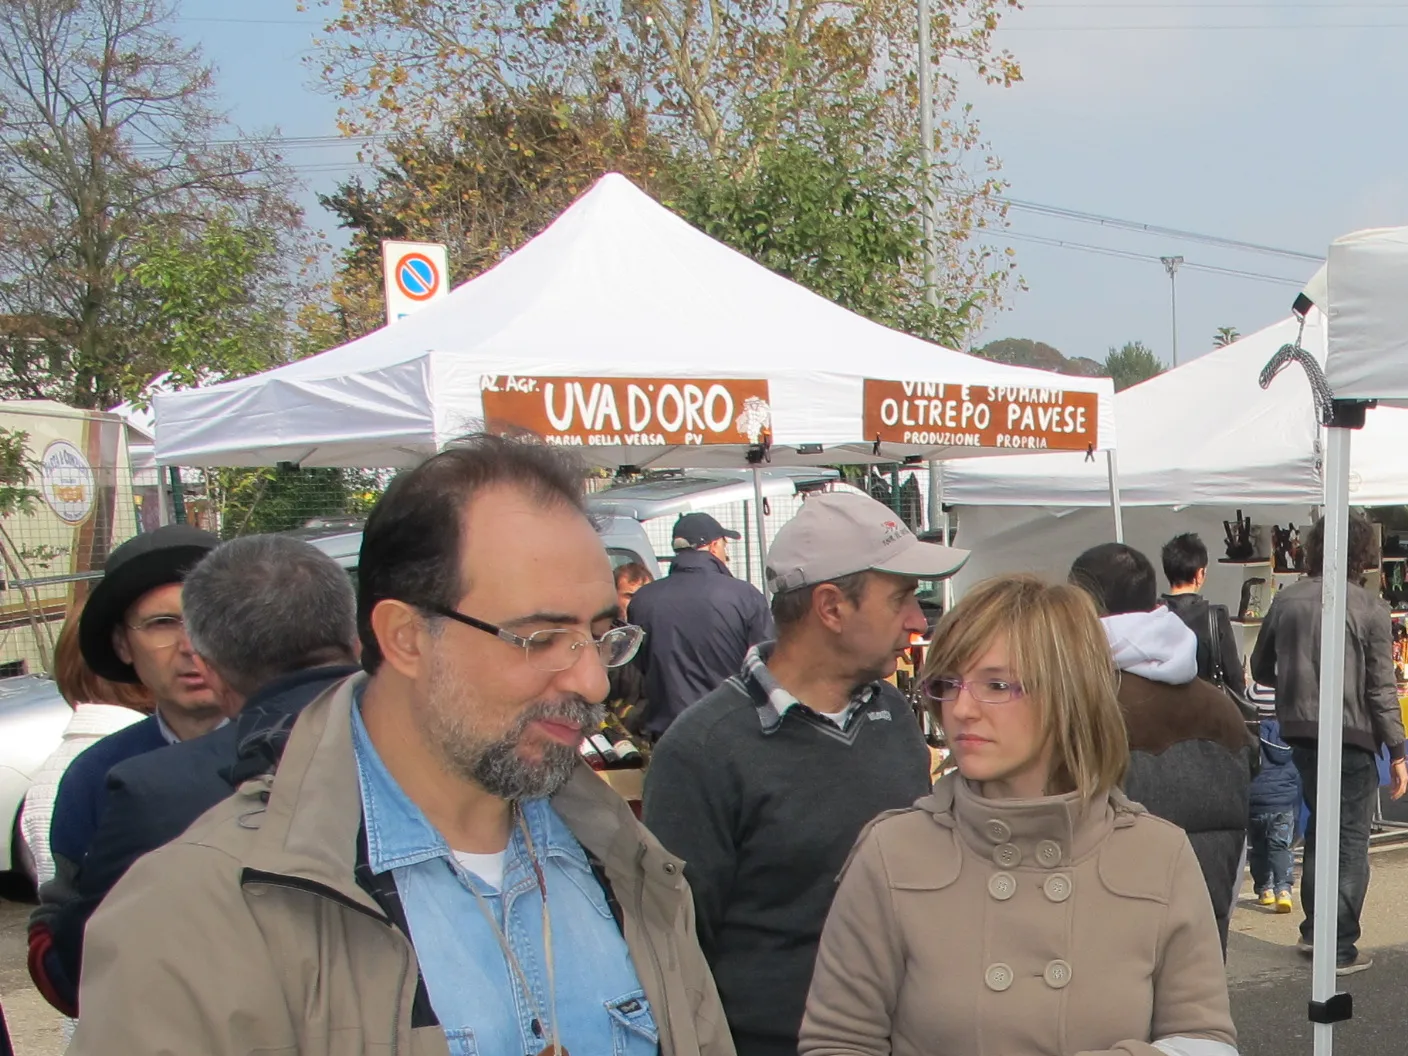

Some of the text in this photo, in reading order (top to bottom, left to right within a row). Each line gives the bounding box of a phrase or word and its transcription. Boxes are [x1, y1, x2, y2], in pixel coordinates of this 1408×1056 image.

[902, 381, 1063, 405] VINI E SPUMANTI
[544, 382, 734, 432] UVA D'ORO
[880, 398, 1086, 433] OLTREPO PAVESE
[546, 434, 583, 446] MARIA
[588, 434, 622, 446] DELLA
[624, 433, 666, 446] VERSA
[684, 432, 703, 446] PV
[903, 431, 1047, 449] PRODUZIONE PROPRIA
